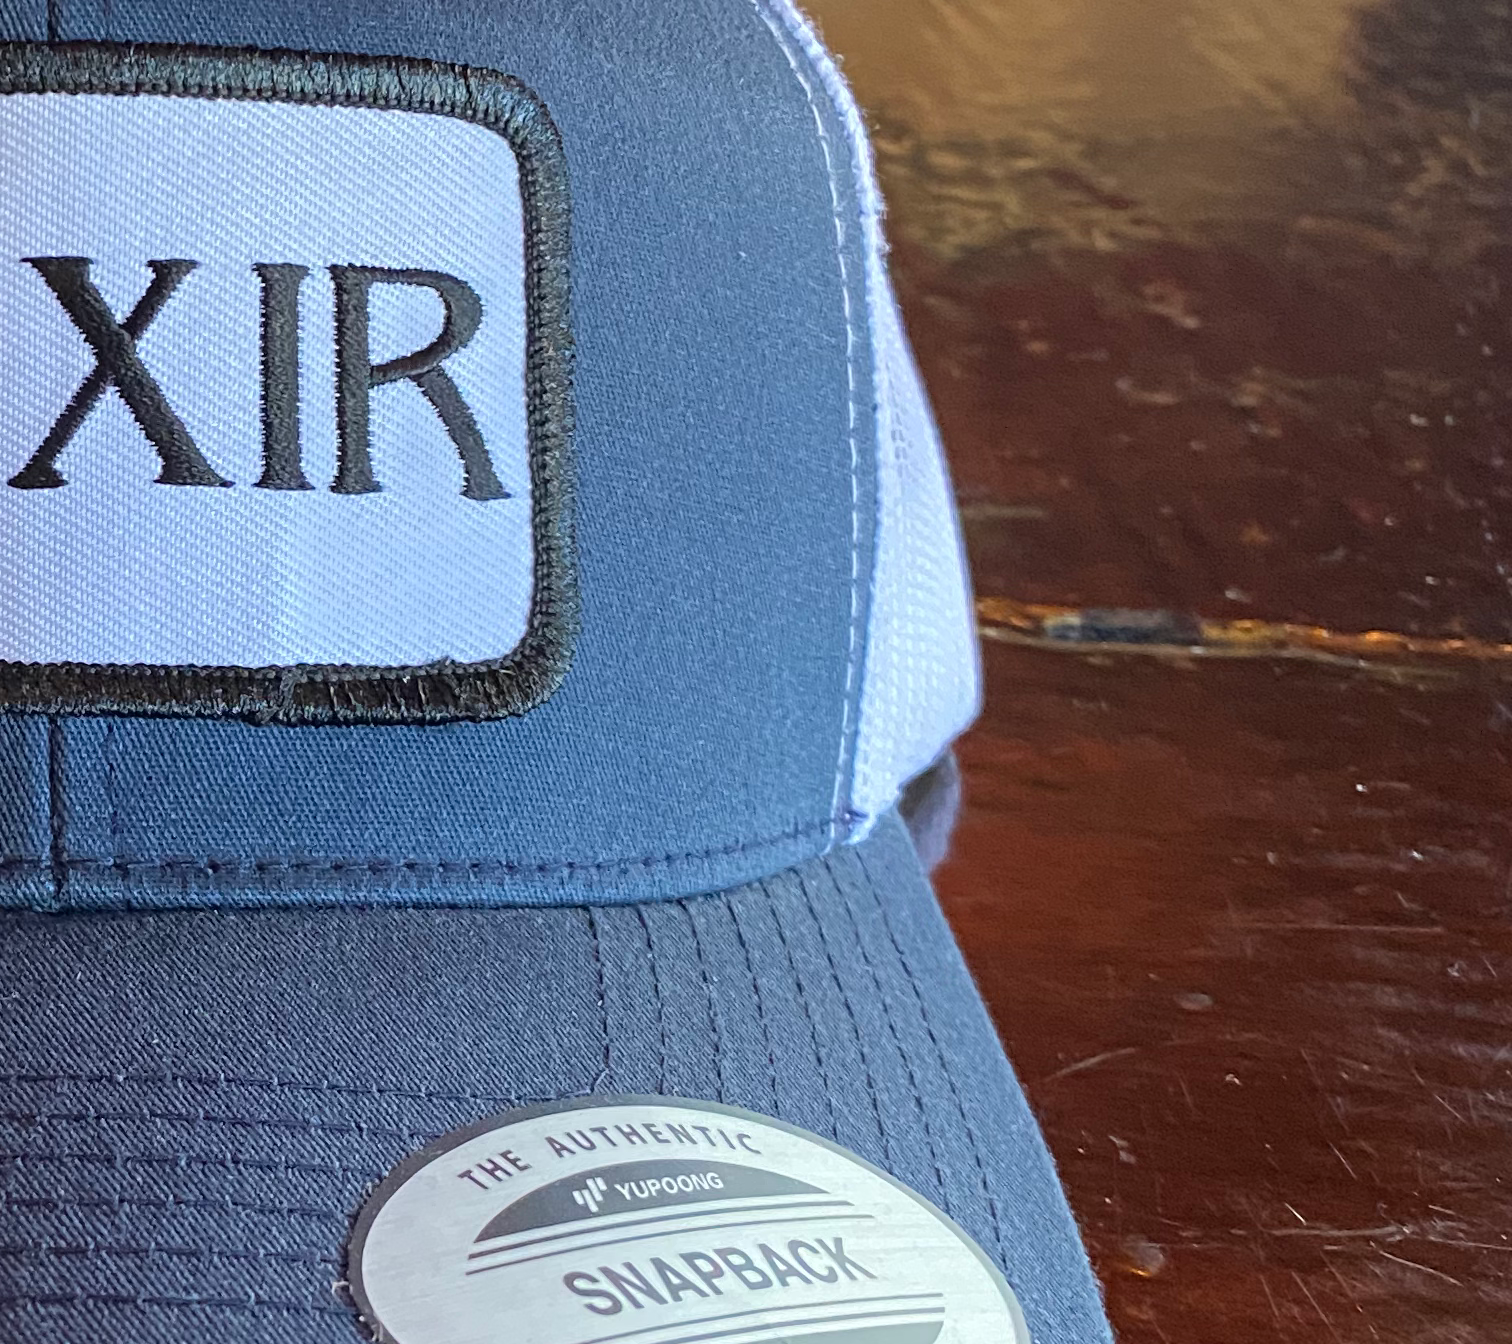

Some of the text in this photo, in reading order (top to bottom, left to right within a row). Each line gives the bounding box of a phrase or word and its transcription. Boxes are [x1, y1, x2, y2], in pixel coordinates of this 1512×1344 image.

[457, 1122, 763, 1191] THE AUTHENTIC
[614, 1171, 725, 1201] YUPOONG
[563, 1237, 878, 1316] SNAPBACK
